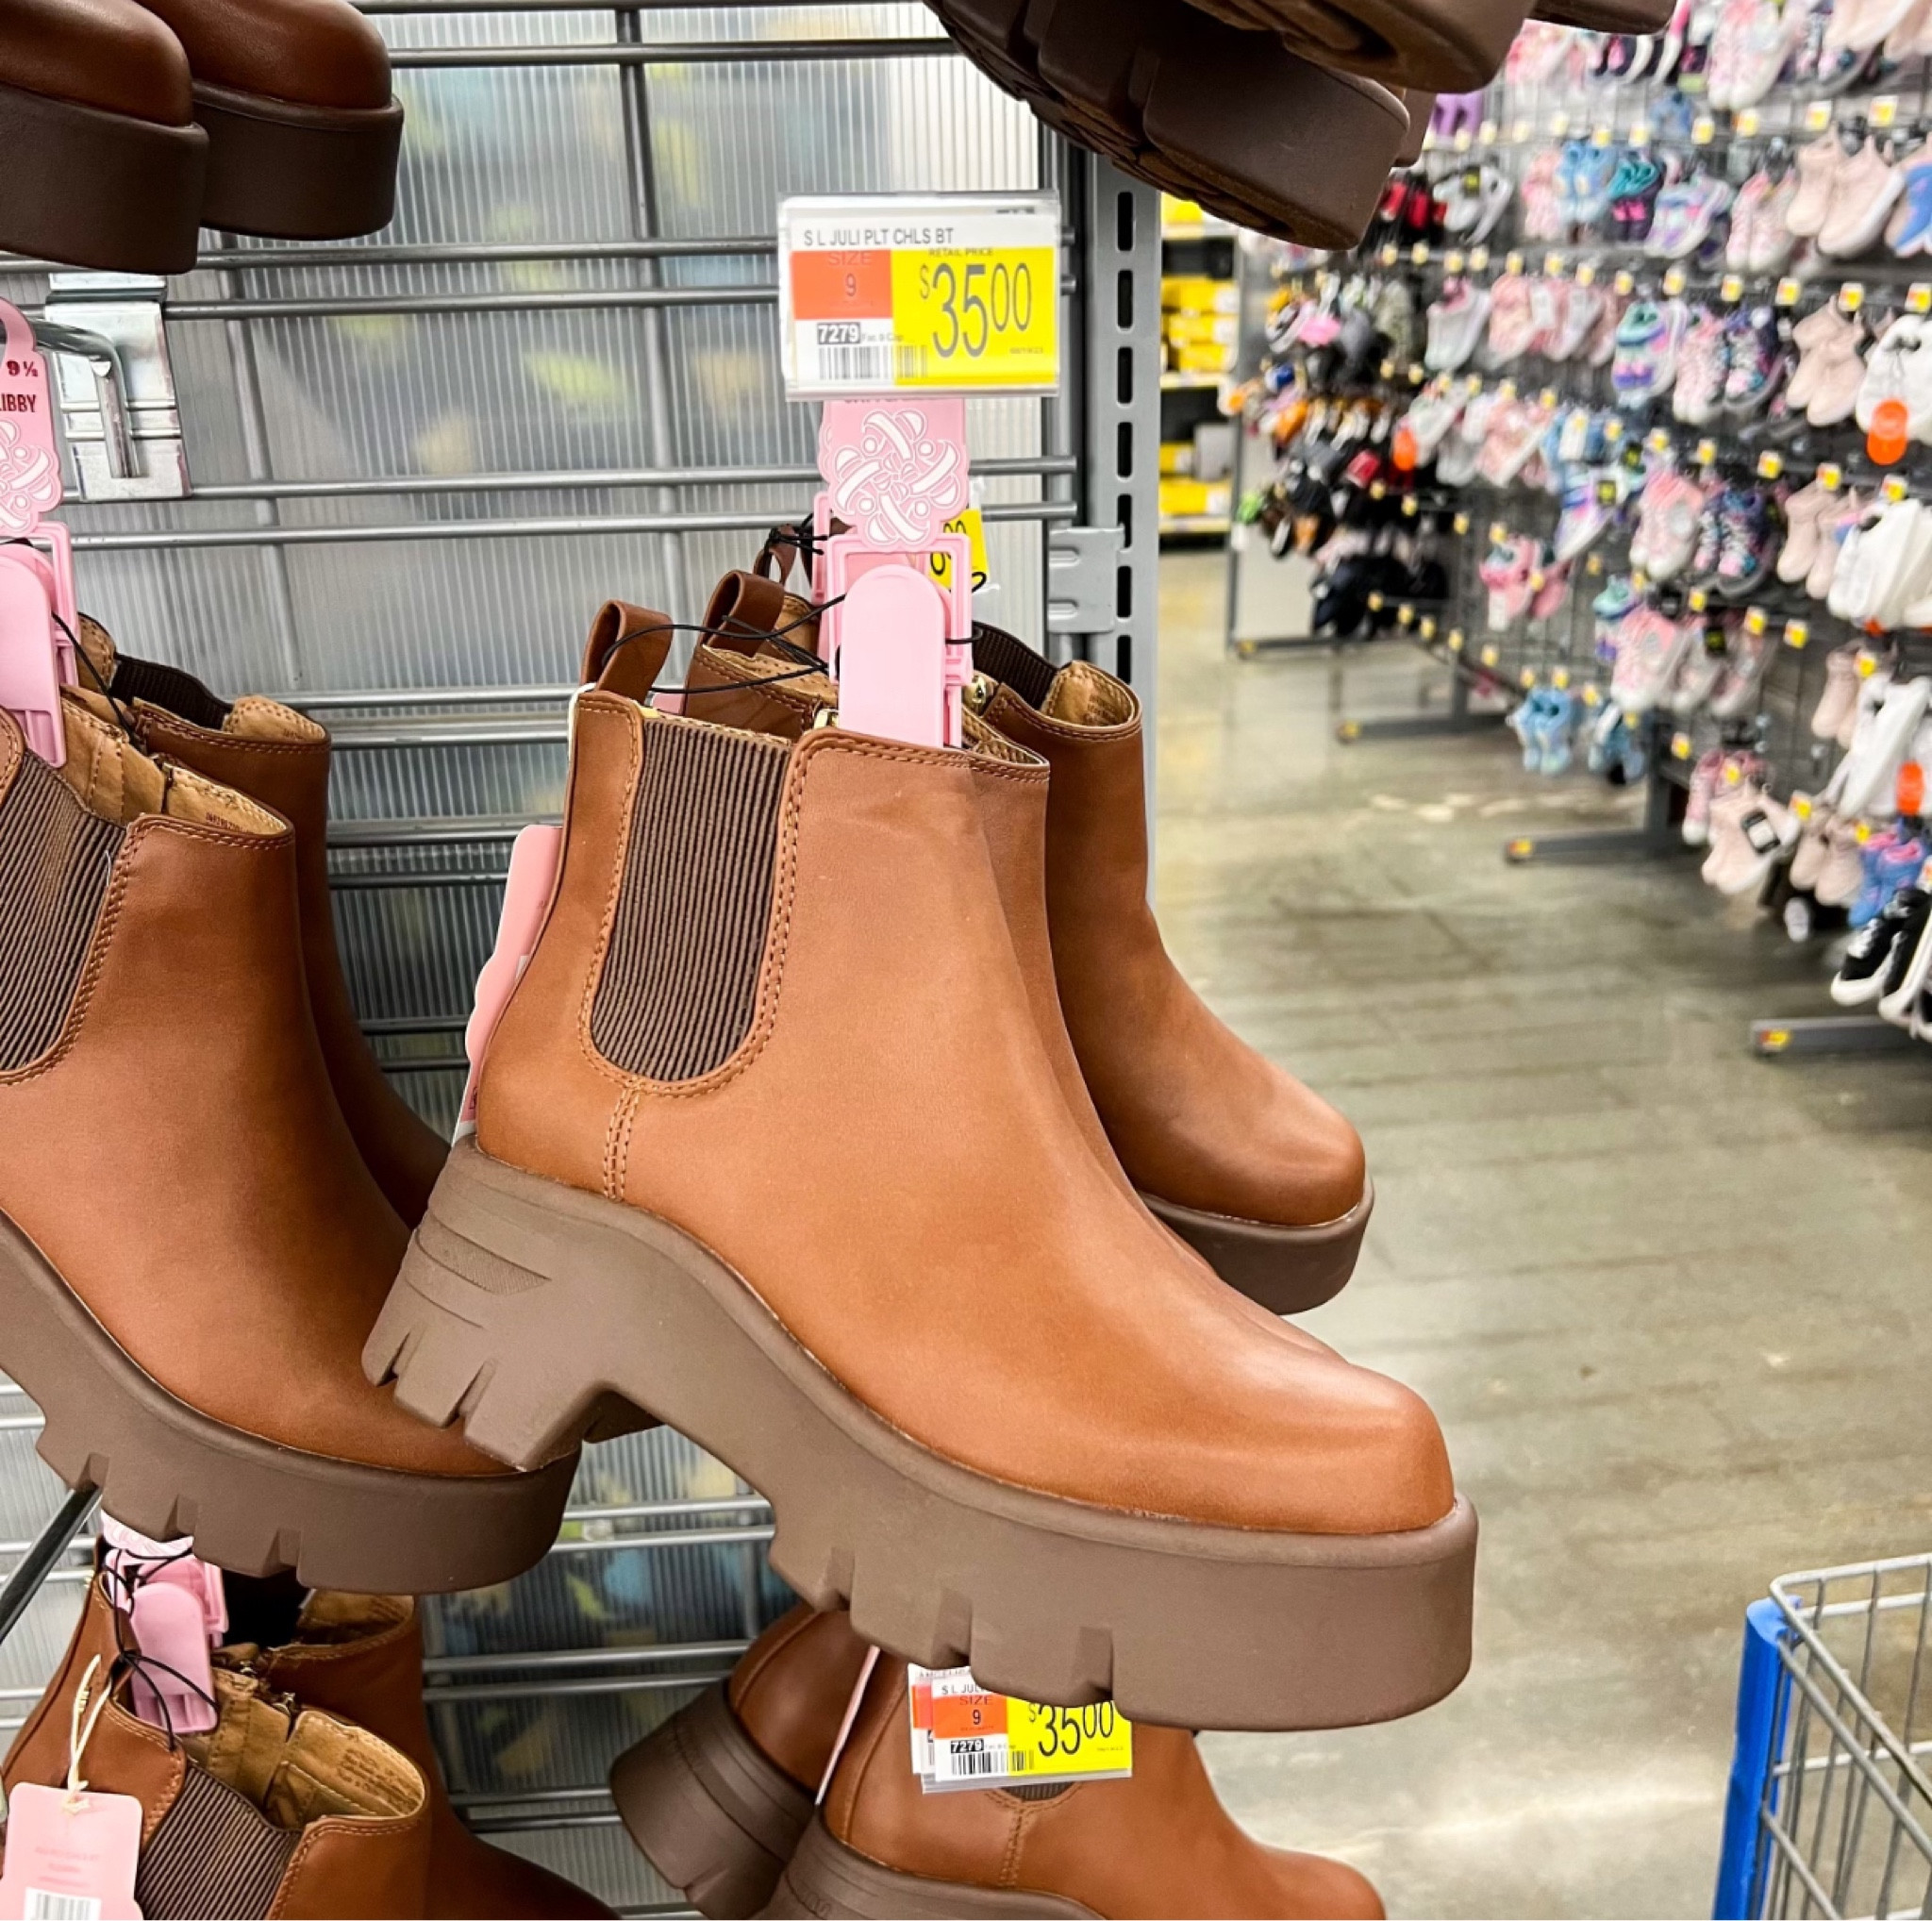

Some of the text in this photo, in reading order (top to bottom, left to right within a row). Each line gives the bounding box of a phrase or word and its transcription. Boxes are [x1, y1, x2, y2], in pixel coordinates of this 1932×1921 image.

[804, 228, 954, 246] S L JULI PLT CHLS BT
[828, 252, 872, 266] SIZE
[844, 274, 857, 297] 9
[818, 324, 860, 343] 7279
[0, 393, 36, 412] IBBY
[941, 1684, 949, 1695] S
[952, 1684, 958, 1694] L
[959, 1695, 993, 1706] SIZE
[973, 1709, 982, 1725] 9
[951, 1740, 983, 1752] 7279
